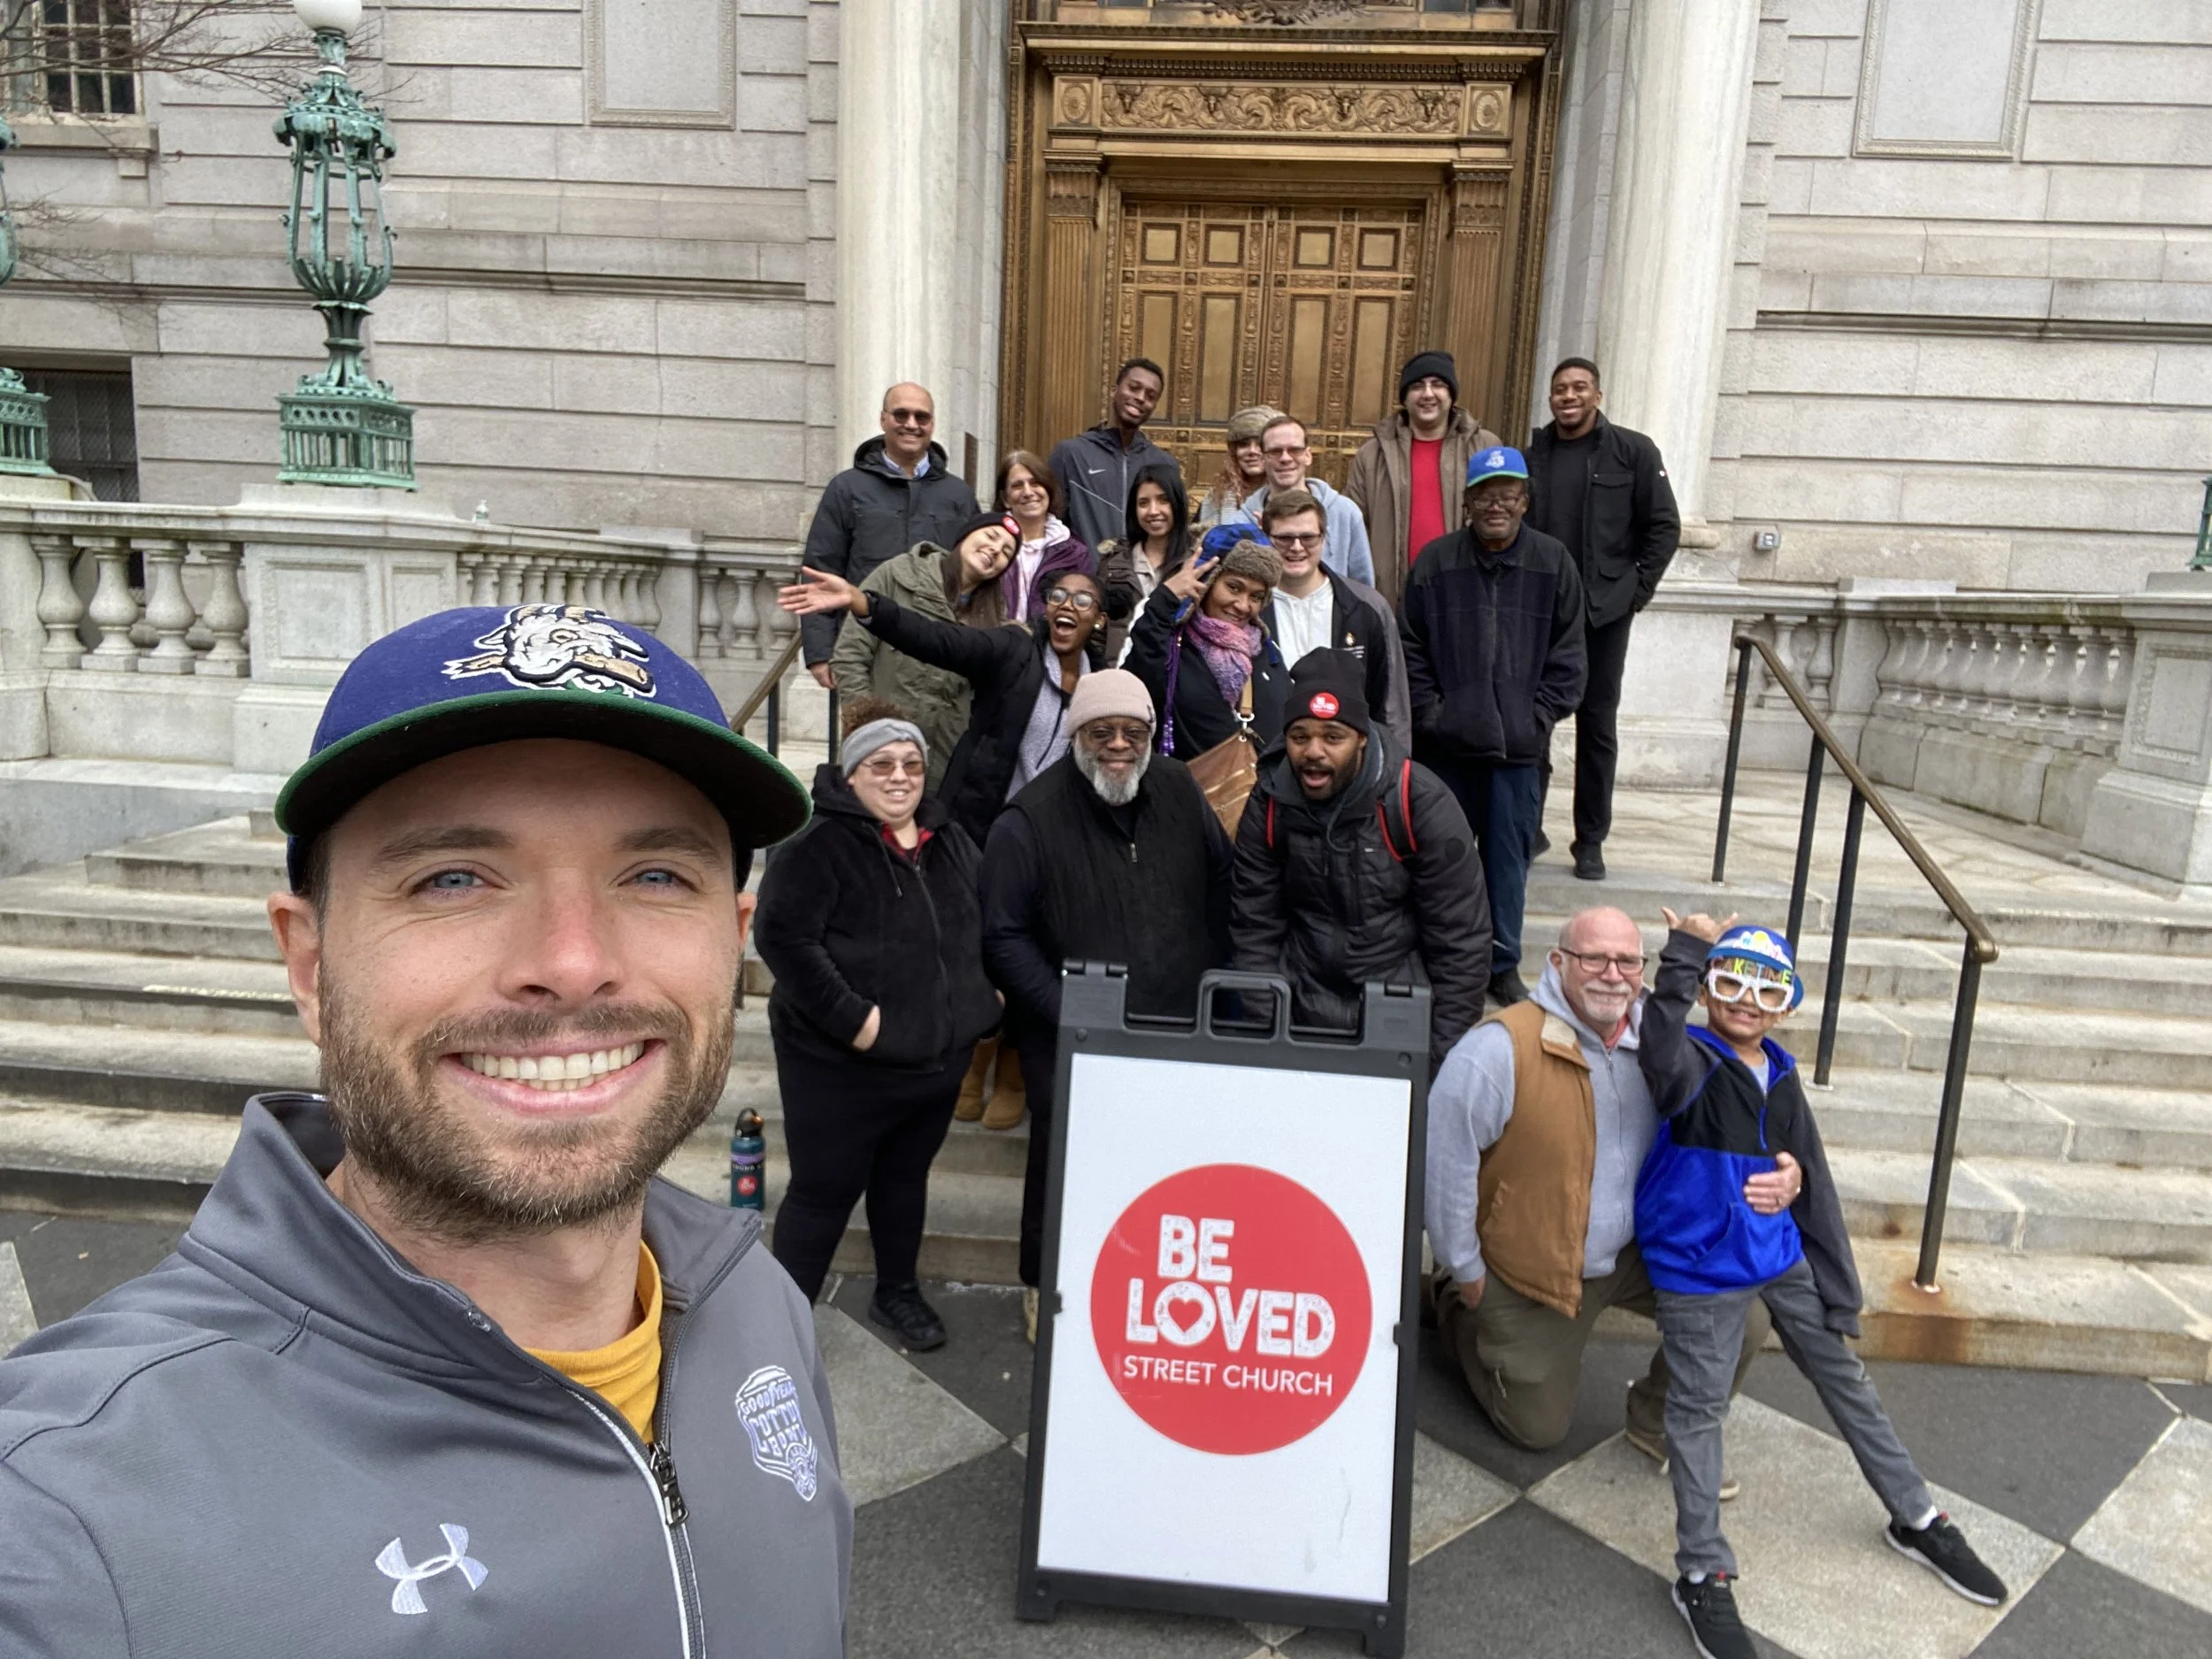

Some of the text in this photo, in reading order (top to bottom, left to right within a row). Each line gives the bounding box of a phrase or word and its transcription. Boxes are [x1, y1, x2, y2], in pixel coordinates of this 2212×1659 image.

[1157, 1214, 1234, 1283] BE
[1125, 1278, 1335, 1358] LOVED
[1123, 1356, 1333, 1396] STREET CHURCH
